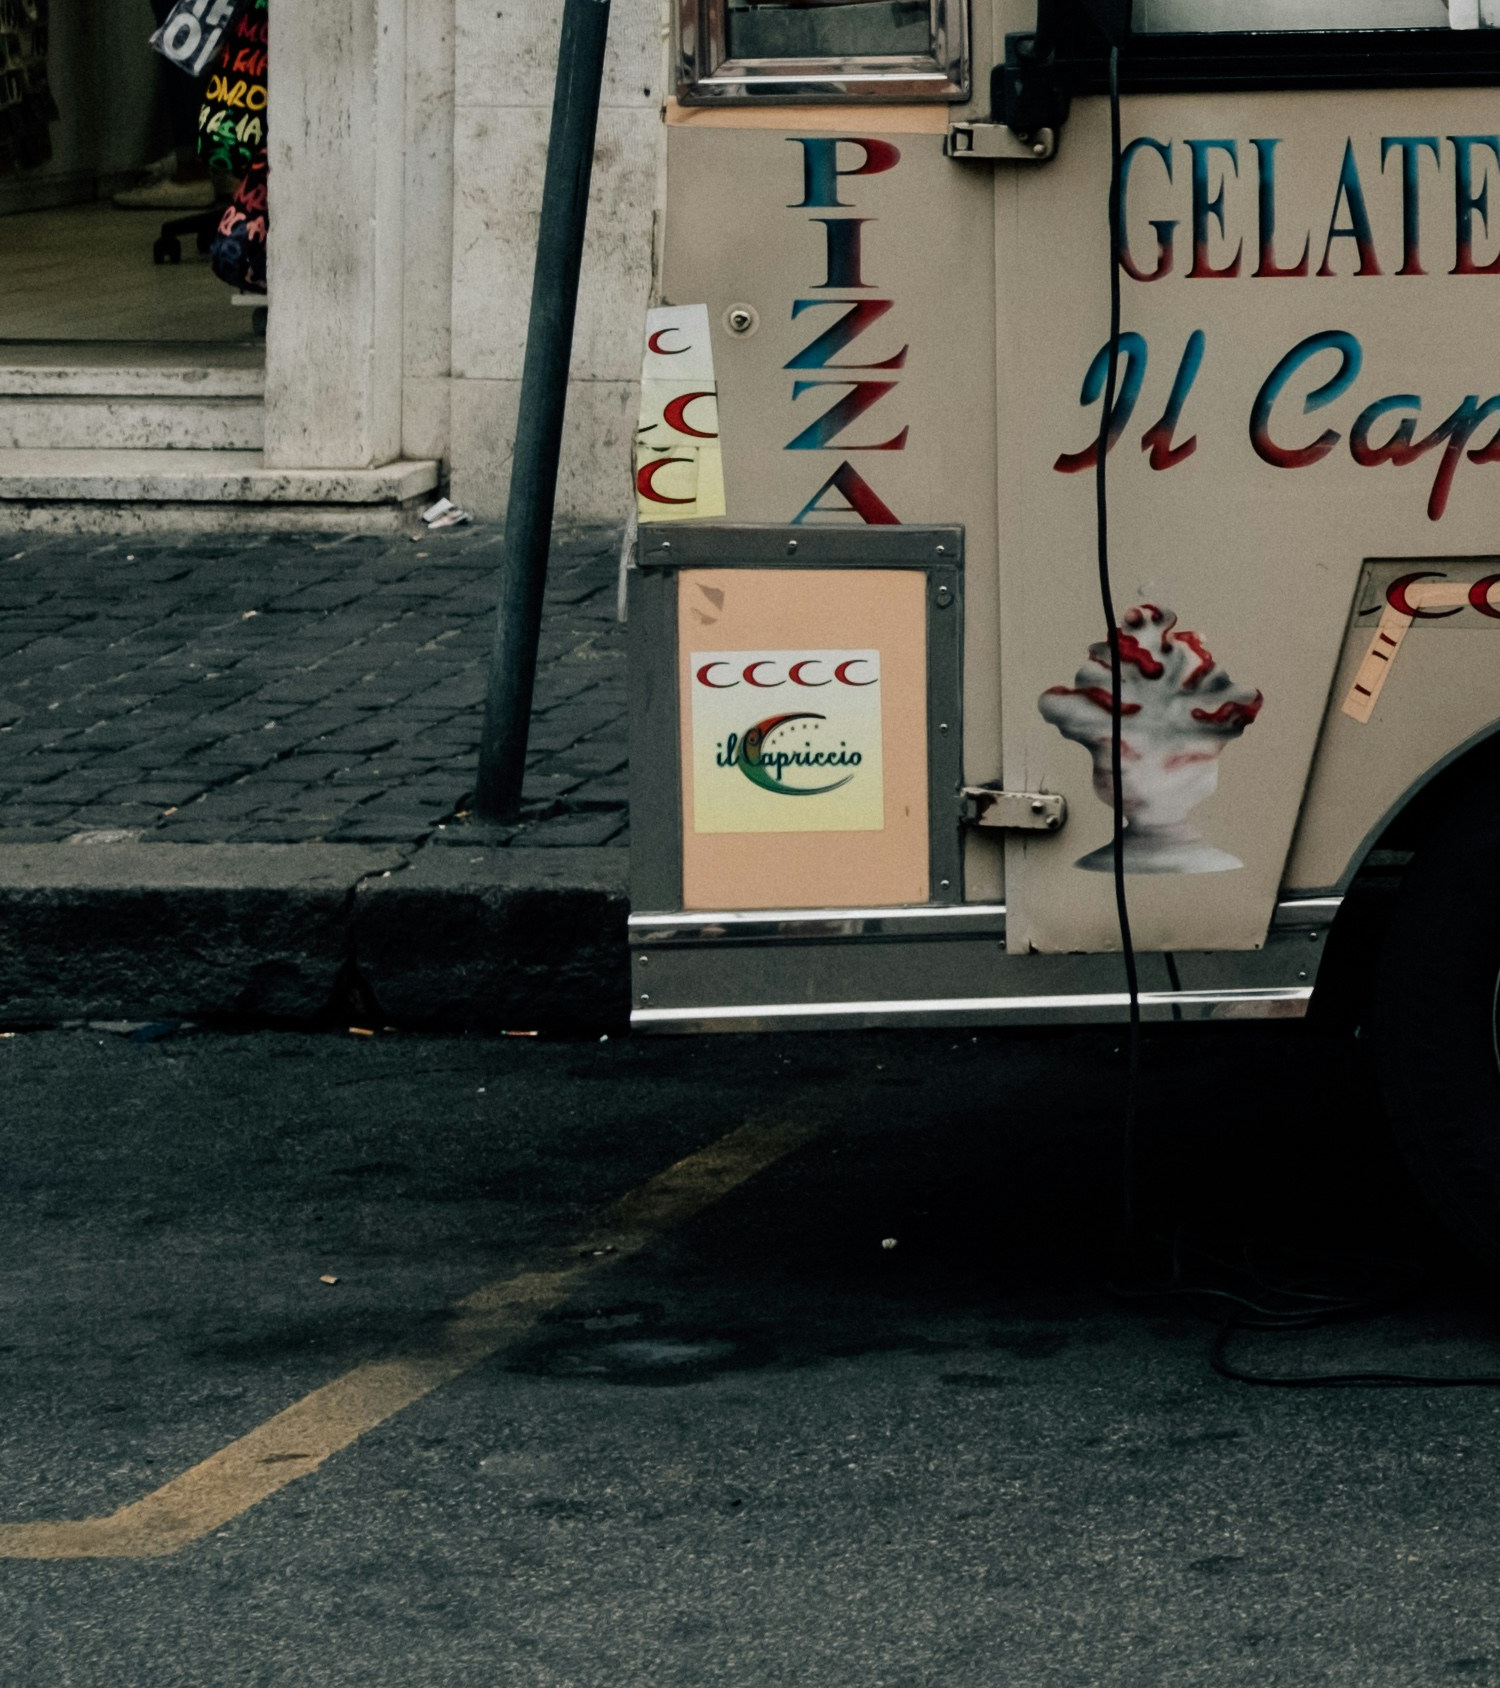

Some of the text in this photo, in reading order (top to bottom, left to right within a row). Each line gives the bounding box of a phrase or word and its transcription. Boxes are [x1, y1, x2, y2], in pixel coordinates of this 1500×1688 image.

[782, 135, 910, 525] PIZZA
[1053, 327, 1205, 472] Il
[716, 727, 863, 781] il Capriccio
